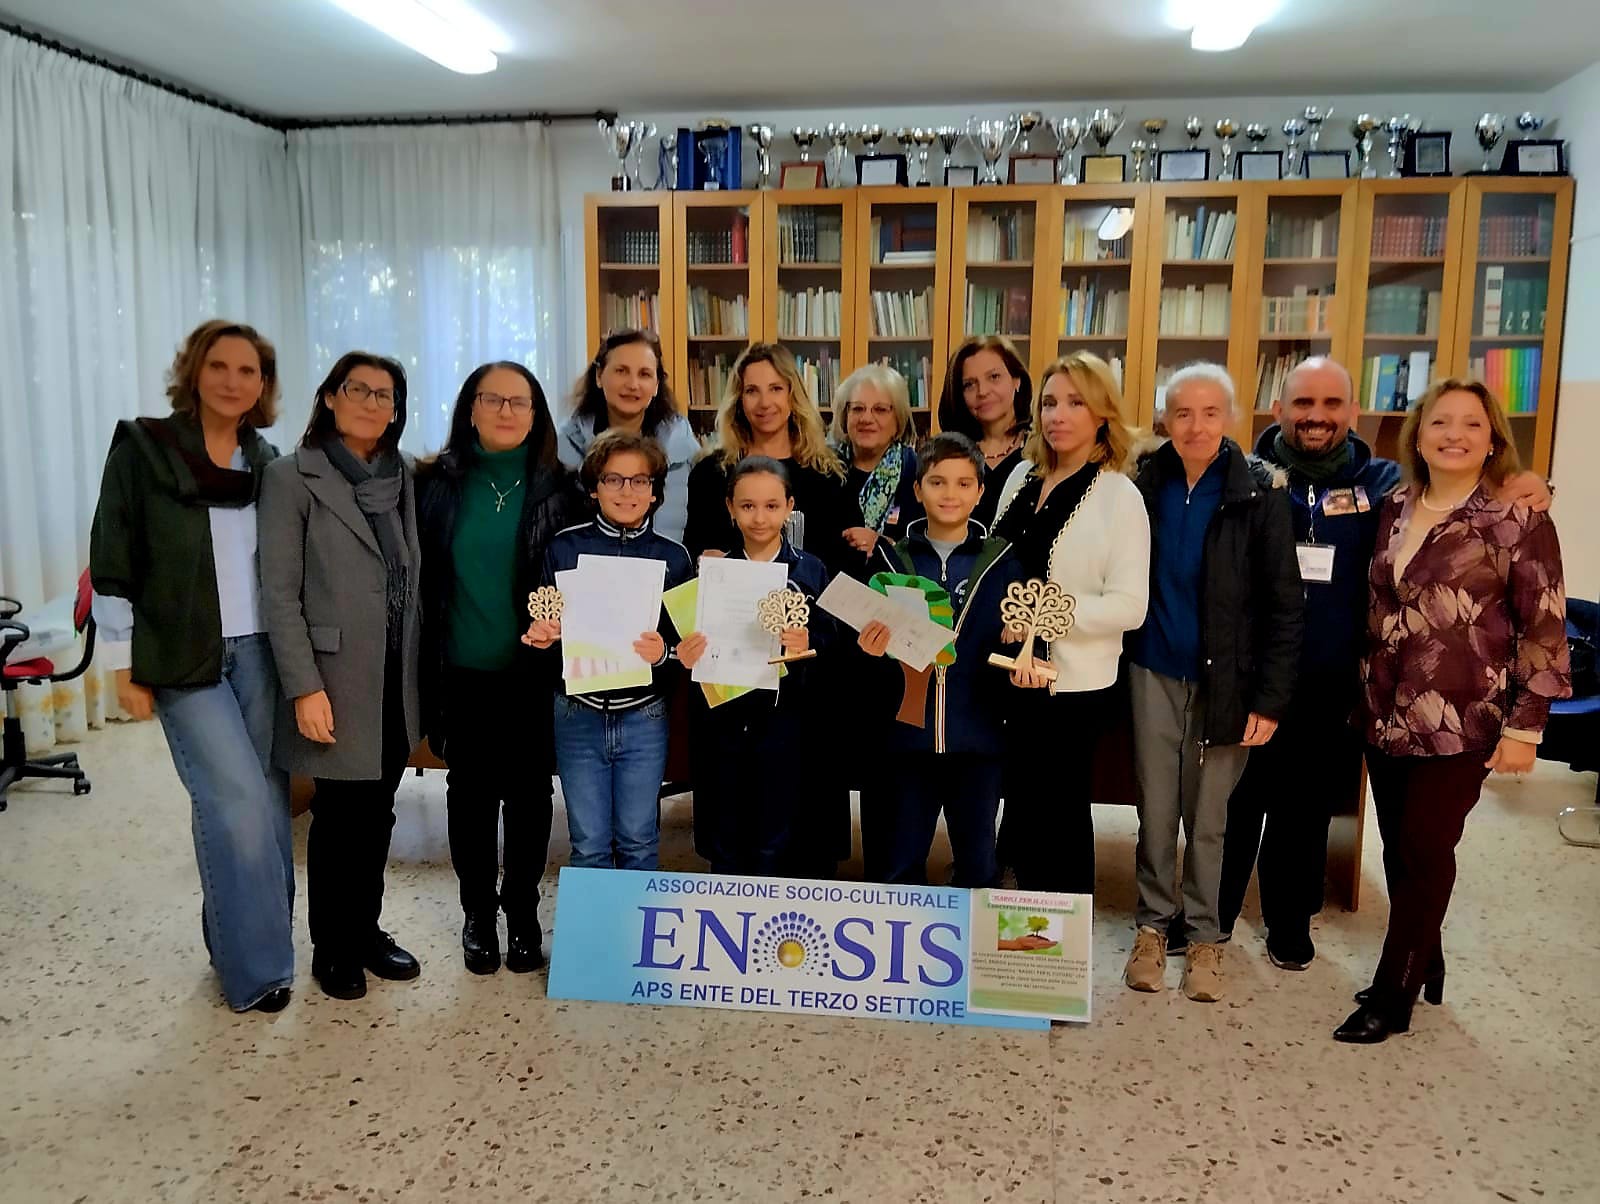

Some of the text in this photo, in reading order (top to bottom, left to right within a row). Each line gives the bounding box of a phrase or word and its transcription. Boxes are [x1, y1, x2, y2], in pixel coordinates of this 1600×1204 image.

[645, 877, 961, 910] ASSOCIAZIONE SOCIO-CULTURALE
[631, 980, 966, 1019] APS ENTE DEL TERZO SETTORE
